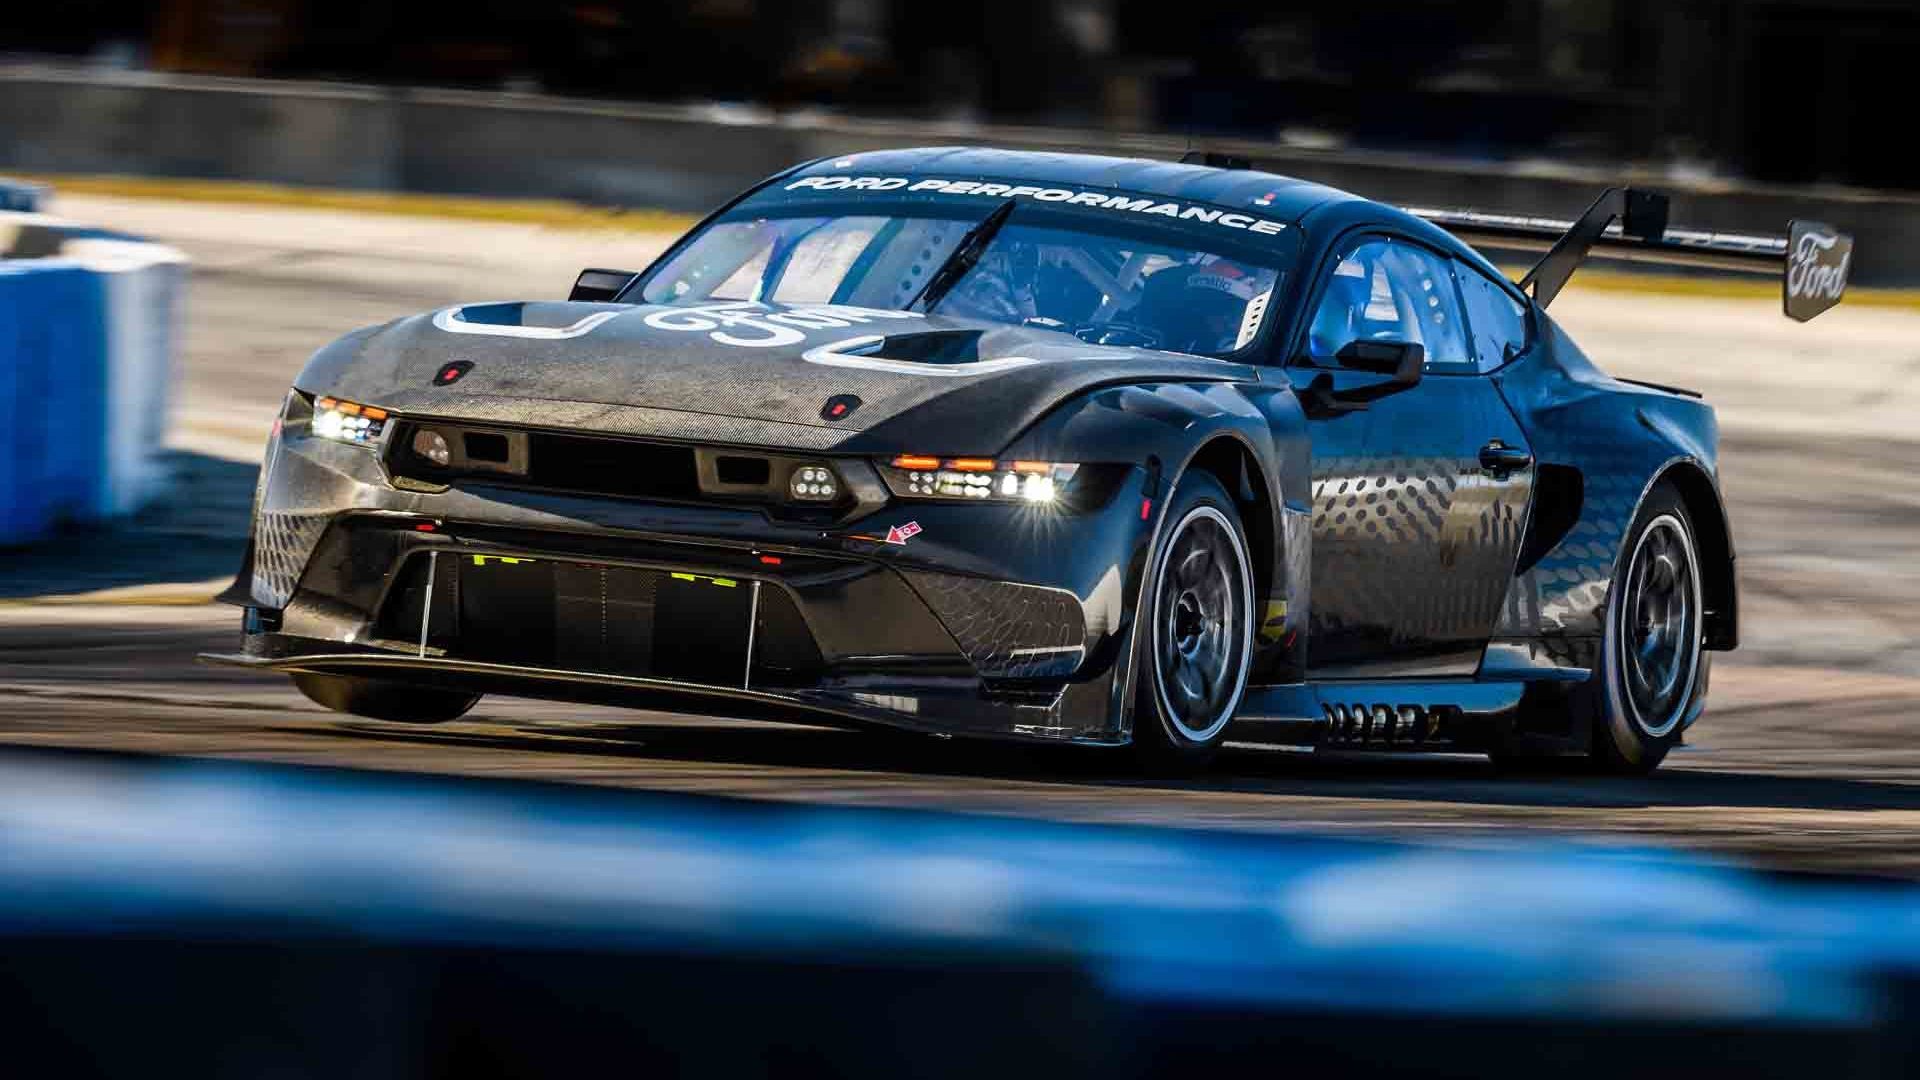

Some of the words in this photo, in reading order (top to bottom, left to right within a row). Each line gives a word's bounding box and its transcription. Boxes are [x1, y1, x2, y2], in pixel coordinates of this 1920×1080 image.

[785, 177, 908, 191] FORD
[908, 179, 1287, 235] PERFORMANCE
[1789, 233, 1850, 298] Ford
